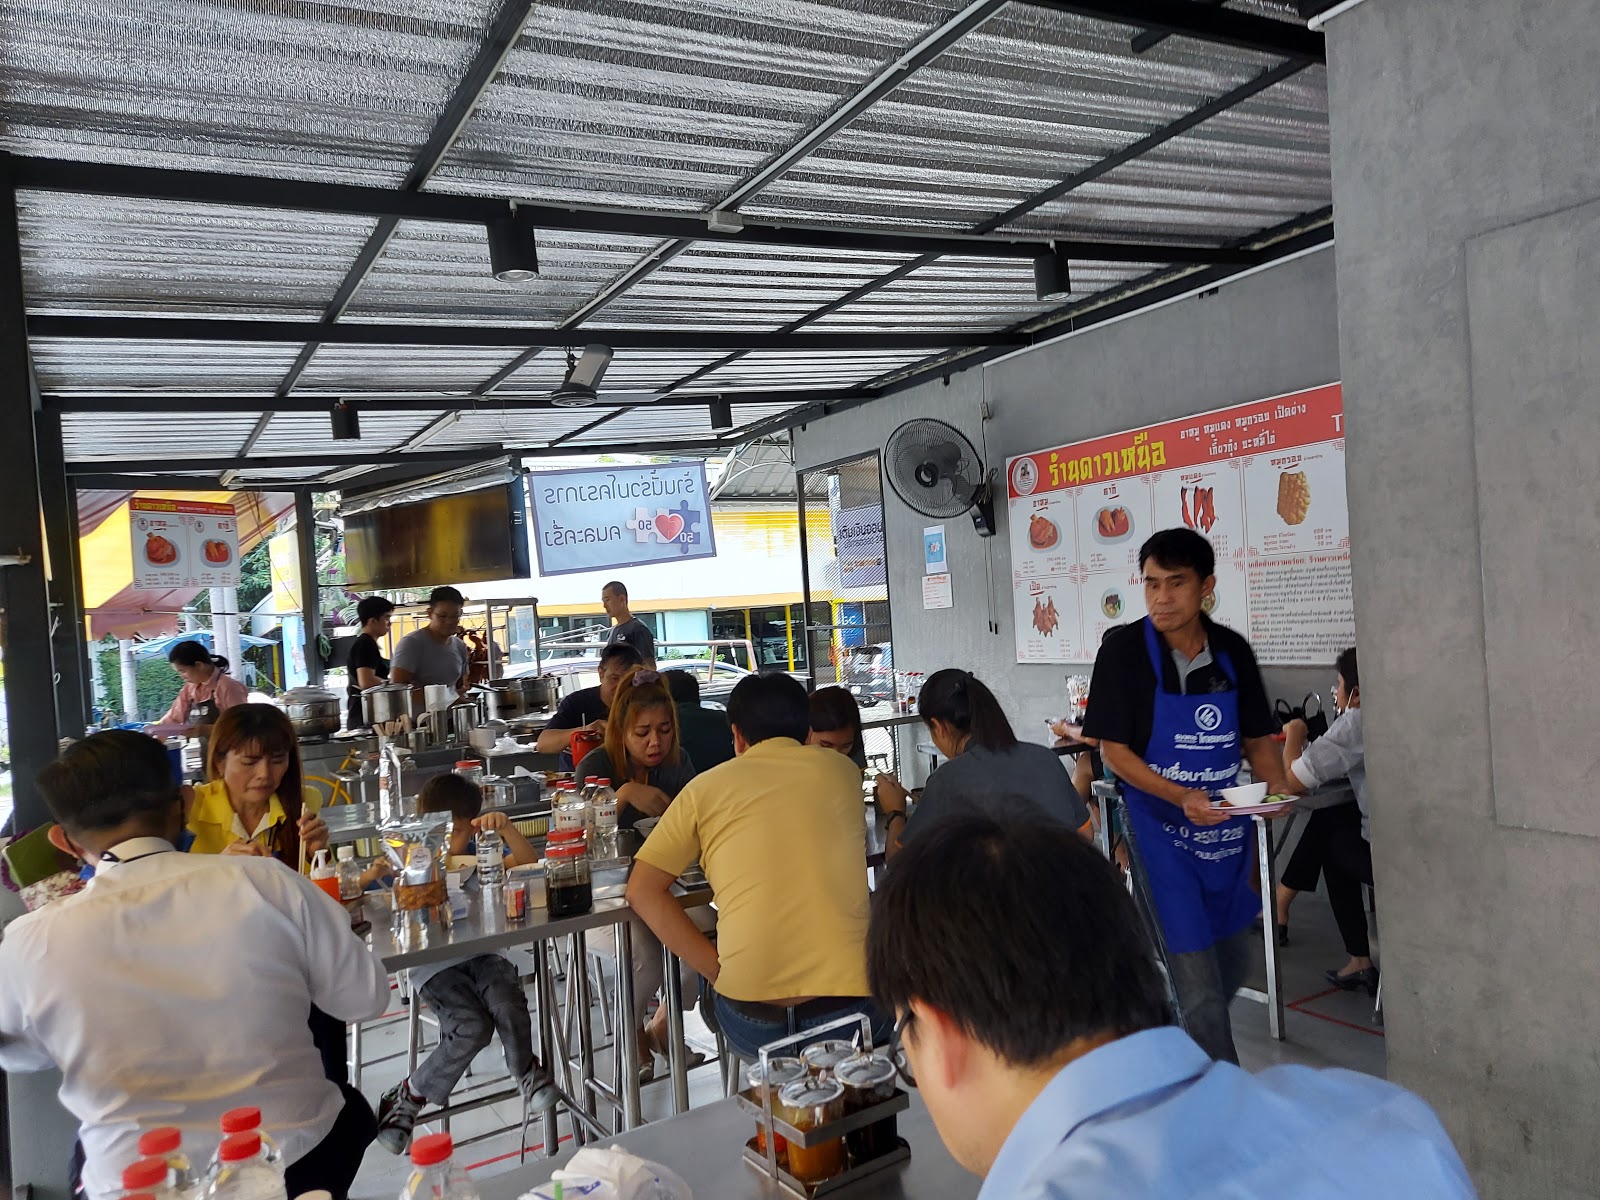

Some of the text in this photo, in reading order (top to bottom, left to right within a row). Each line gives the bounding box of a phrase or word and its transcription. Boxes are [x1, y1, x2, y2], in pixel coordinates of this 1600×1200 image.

[1203, 419, 1231, 437] หมูแดง
[1235, 413, 1270, 431] หมูกรอบ
[1048, 431, 1167, 487] ร้านดาวเหนือ
